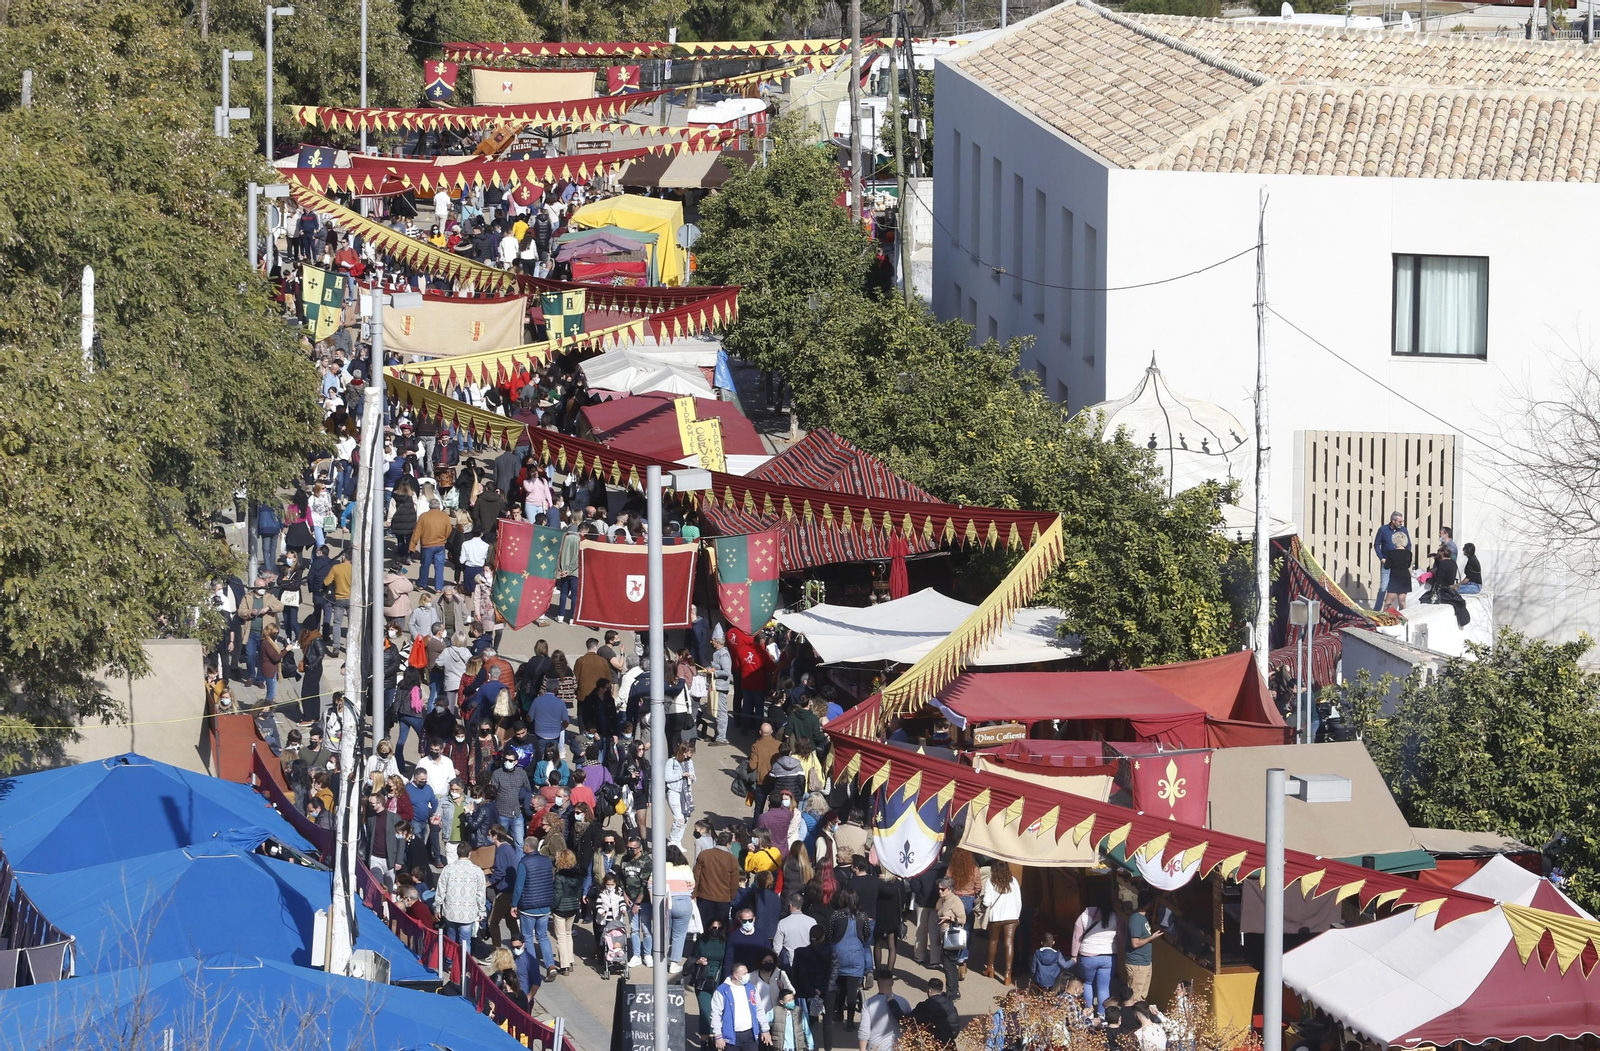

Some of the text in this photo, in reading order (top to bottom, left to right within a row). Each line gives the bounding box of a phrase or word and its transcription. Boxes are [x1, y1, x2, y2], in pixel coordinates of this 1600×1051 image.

[711, 422, 724, 472] HIDROMIE
[975, 732, 1026, 743] Vino Caliente
[626, 992, 685, 1007] PESTO
